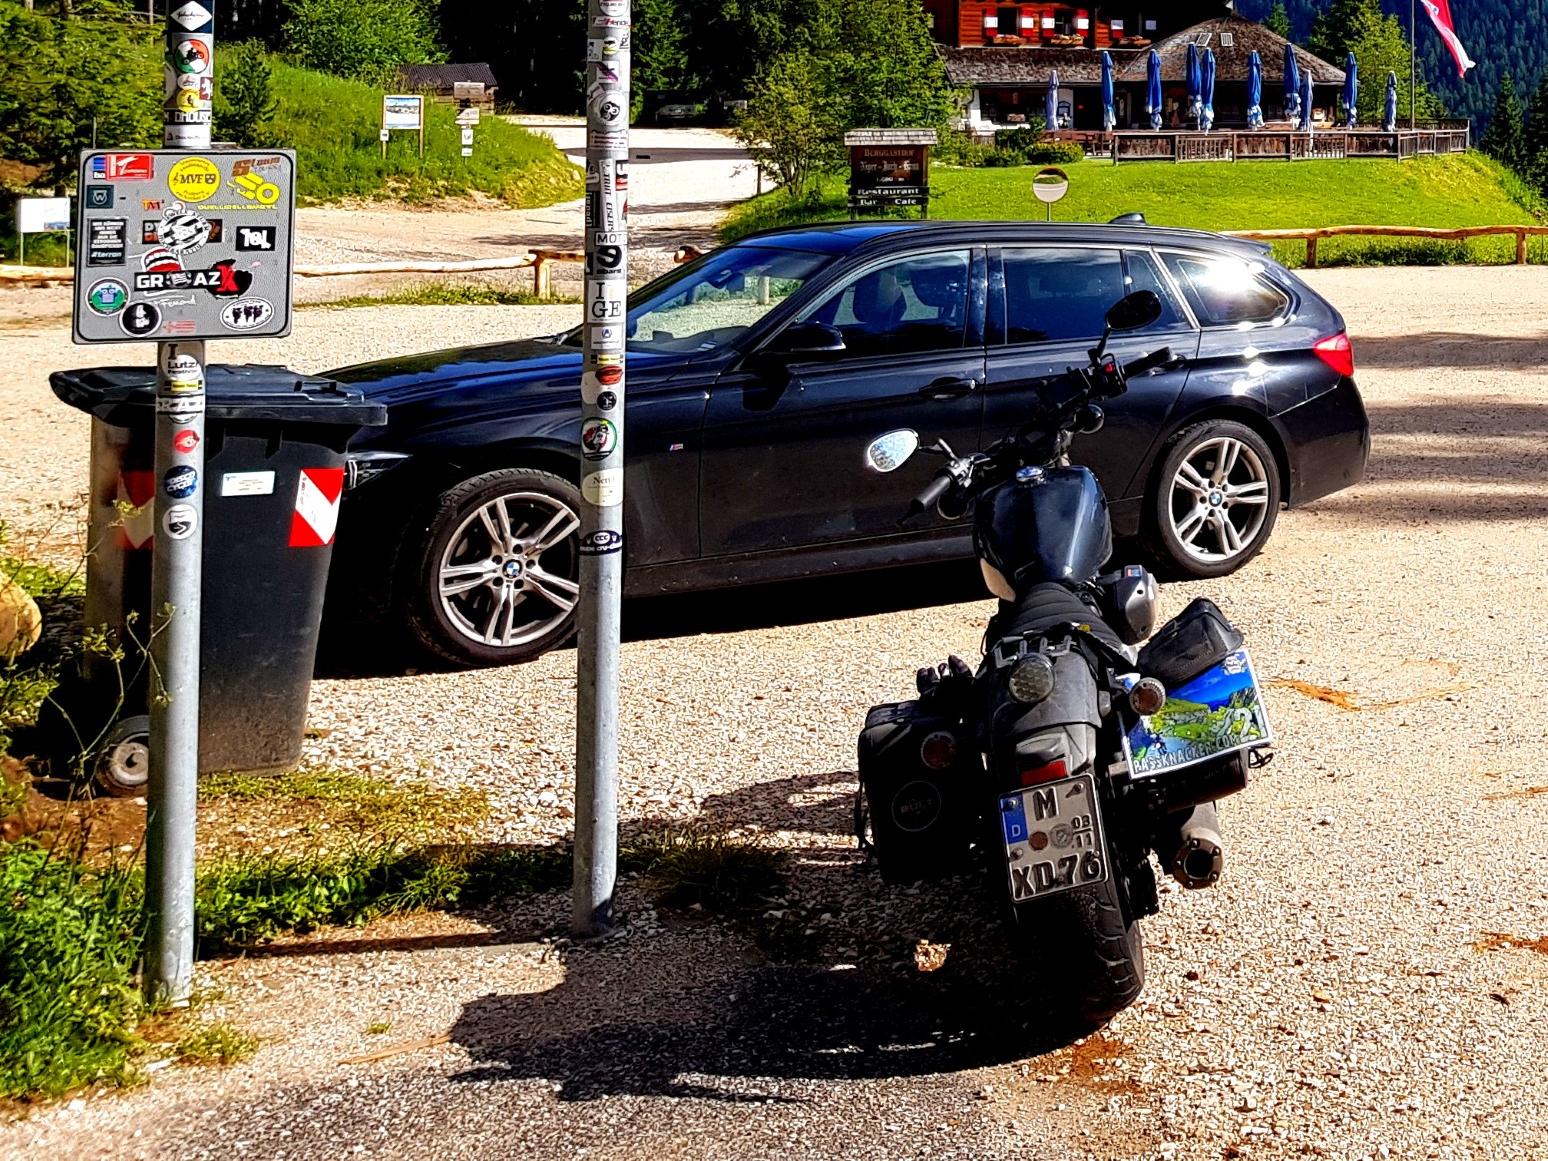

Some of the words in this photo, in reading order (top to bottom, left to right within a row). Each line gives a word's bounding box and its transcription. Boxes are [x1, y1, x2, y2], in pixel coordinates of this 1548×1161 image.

[1133, 734, 1242, 773] PASSKNACKER.COM
[1032, 786, 1060, 821] M
[1011, 824, 1021, 838] D
